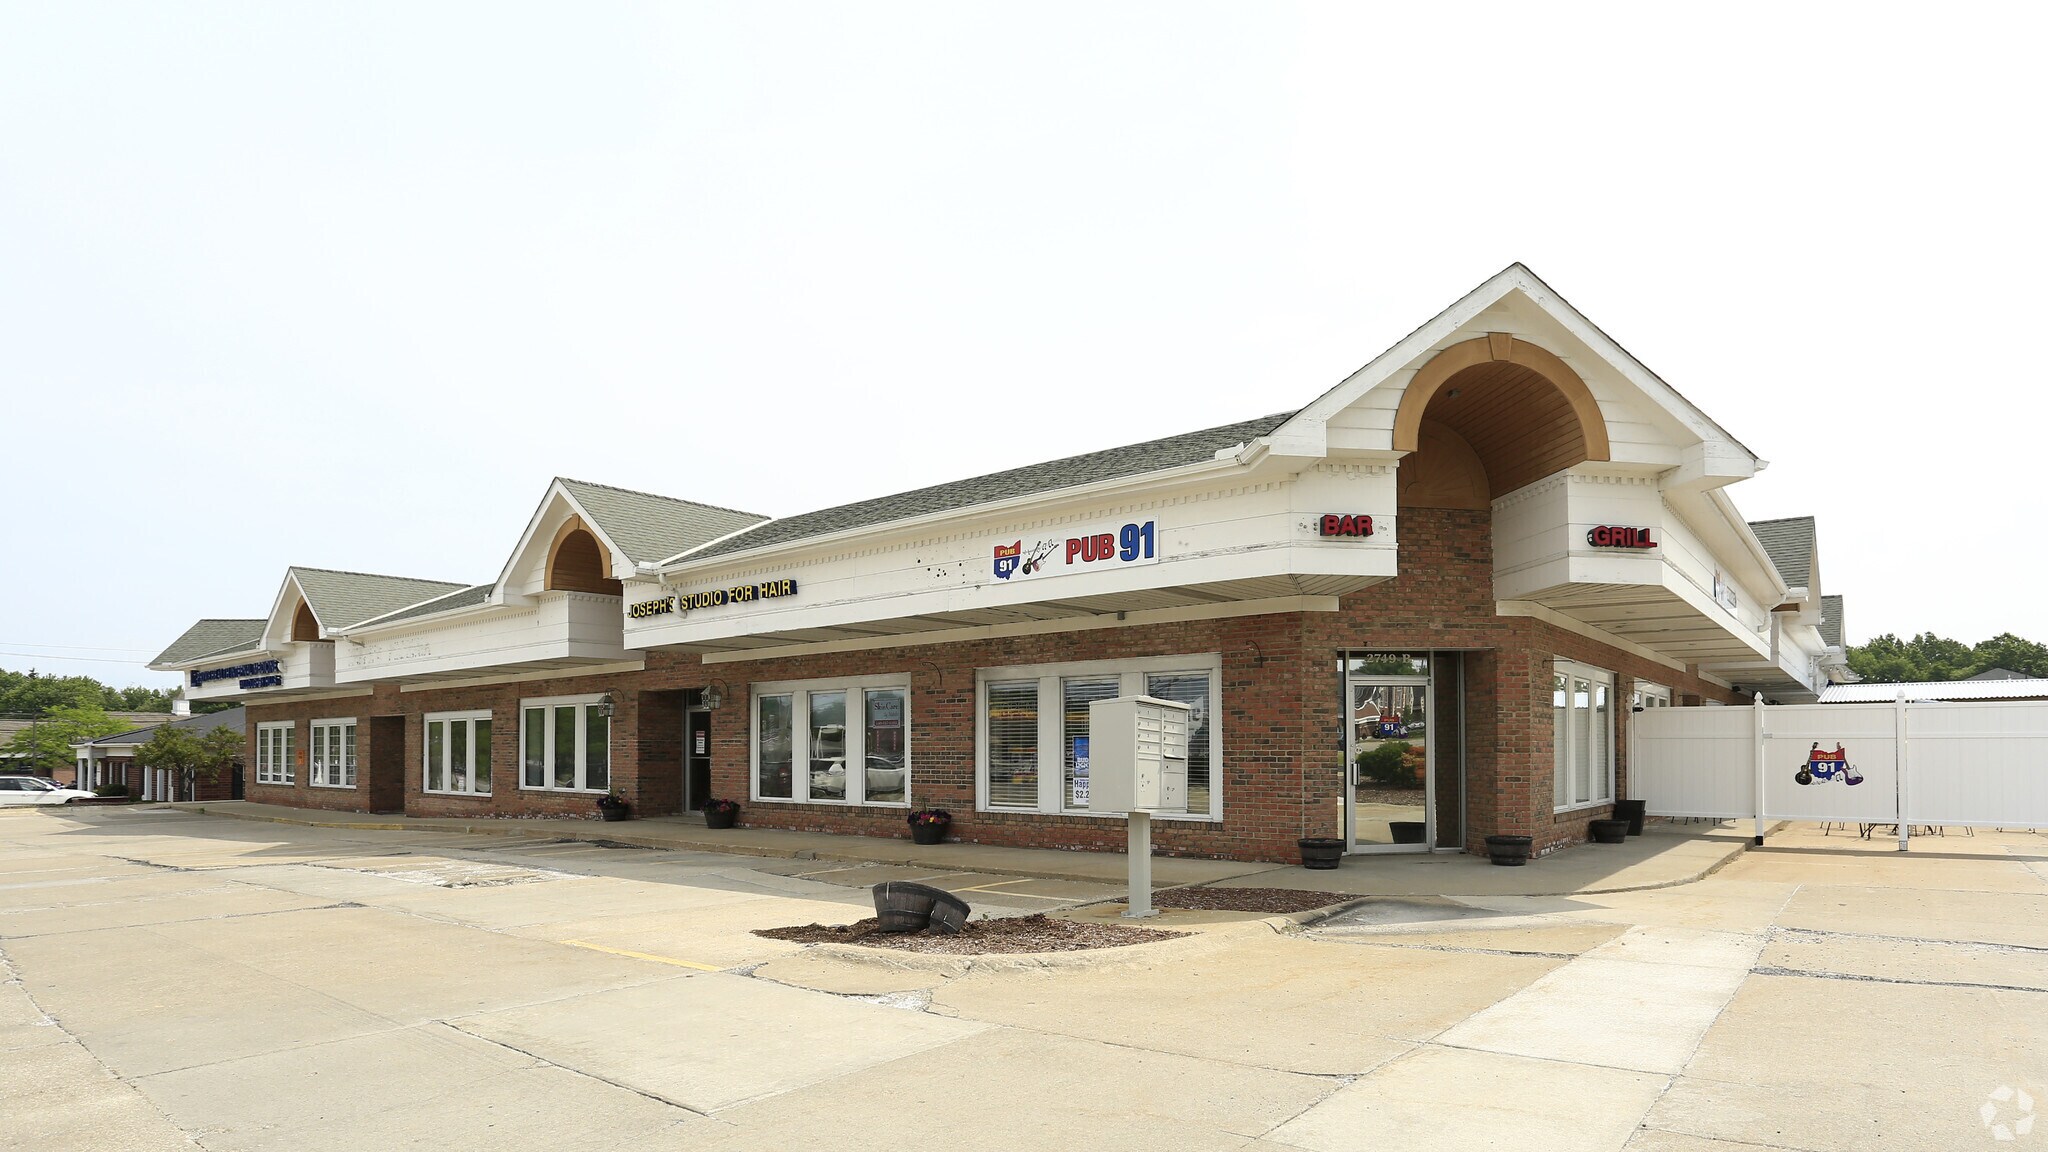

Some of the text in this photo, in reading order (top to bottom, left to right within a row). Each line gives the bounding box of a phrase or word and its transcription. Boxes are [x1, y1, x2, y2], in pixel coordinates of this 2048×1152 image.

[1321, 514, 1374, 536] BAR
[1065, 520, 1155, 565] PUB 91
[1590, 525, 1657, 548] GRILL
[999, 547, 1016, 556] PUB
[999, 559, 1013, 572] 91
[627, 579, 792, 618] JOSEPH'S STUDIO FOR HAIR
[1384, 723, 1394, 731] 91
[1817, 762, 1836, 773] 91
